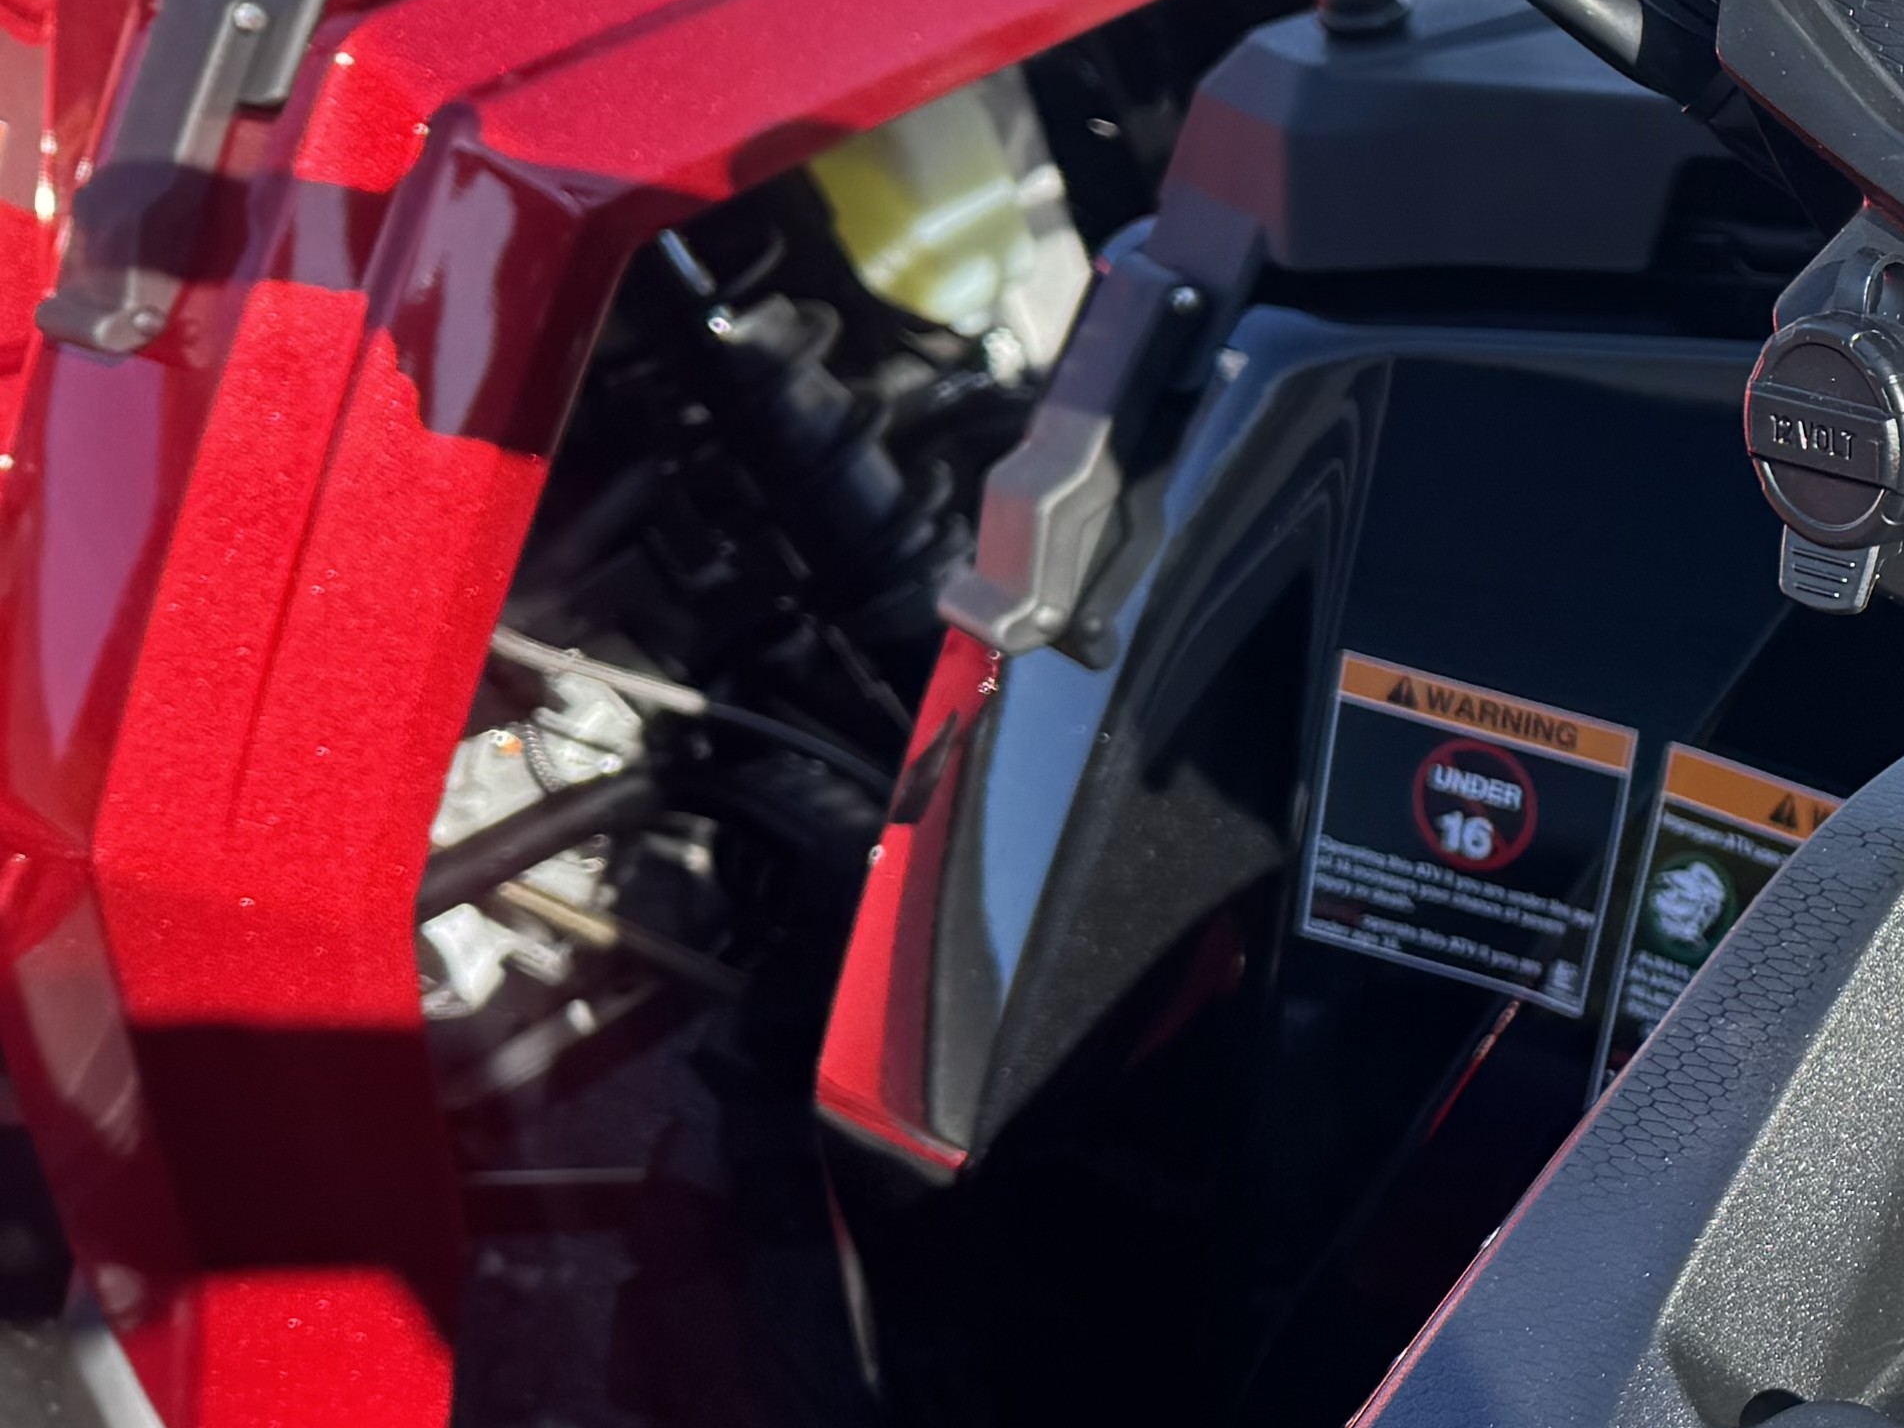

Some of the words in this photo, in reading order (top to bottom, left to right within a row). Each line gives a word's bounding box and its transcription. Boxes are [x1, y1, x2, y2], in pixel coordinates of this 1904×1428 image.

[1769, 411, 1793, 444] 12
[1797, 419, 1858, 462] VOLT
[1425, 684, 1581, 753] WARNING
[1427, 764, 1524, 811] UNDER
[1435, 810, 1497, 861] 16
